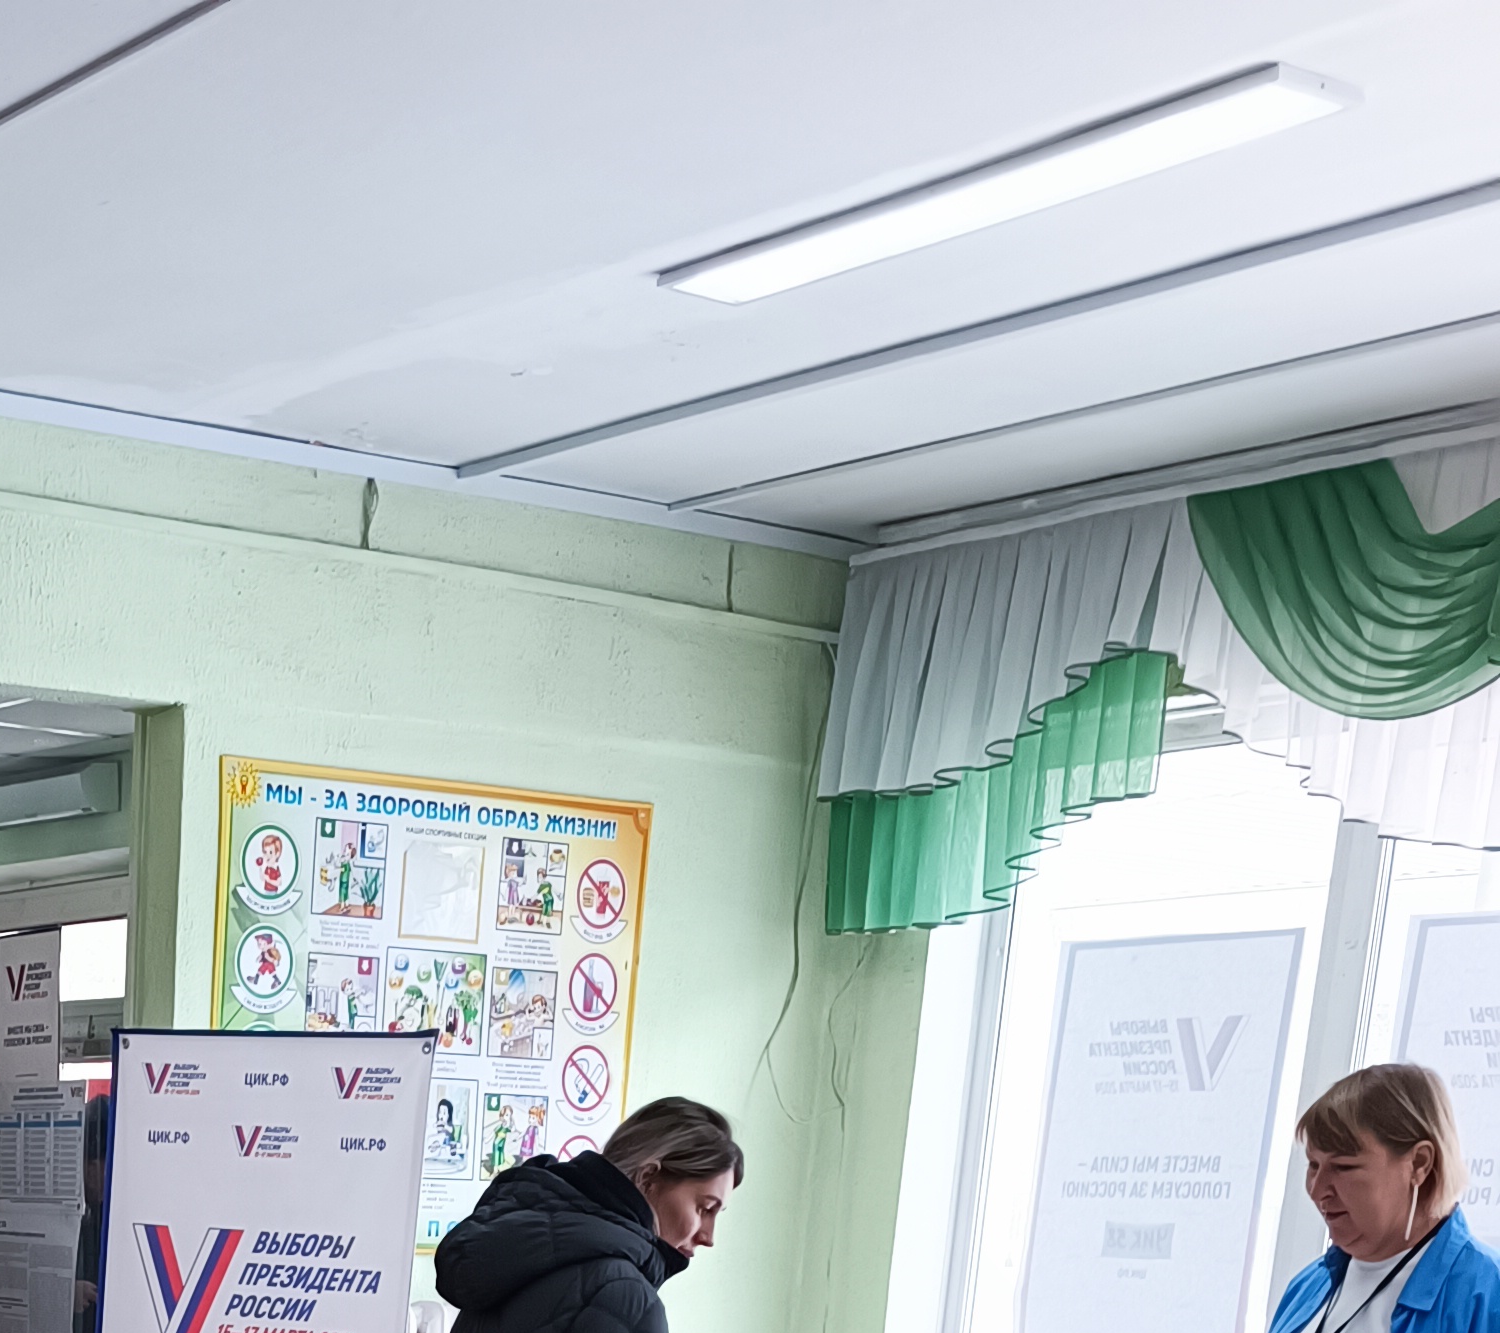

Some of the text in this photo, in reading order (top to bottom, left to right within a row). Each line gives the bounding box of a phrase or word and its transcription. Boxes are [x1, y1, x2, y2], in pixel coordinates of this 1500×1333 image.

[265, 783, 303, 805] МЫ
[324, 788, 349, 811] ЗА
[355, 792, 471, 823] ЗДОРОВЫЙ
[477, 806, 539, 831] ОБРАЗ
[544, 814, 618, 840] ЖИЗНИ!
[245, 1073, 288, 1088] ЦИК.РФ
[148, 1130, 190, 1145] ЦИК.РФ
[340, 1138, 387, 1152] ЦИК.РФ
[251, 1231, 356, 1259] ВЫБОРЫ
[238, 1262, 382, 1295] ПРЕЗИДЕНТА
[224, 1293, 317, 1322] РОССИИ
